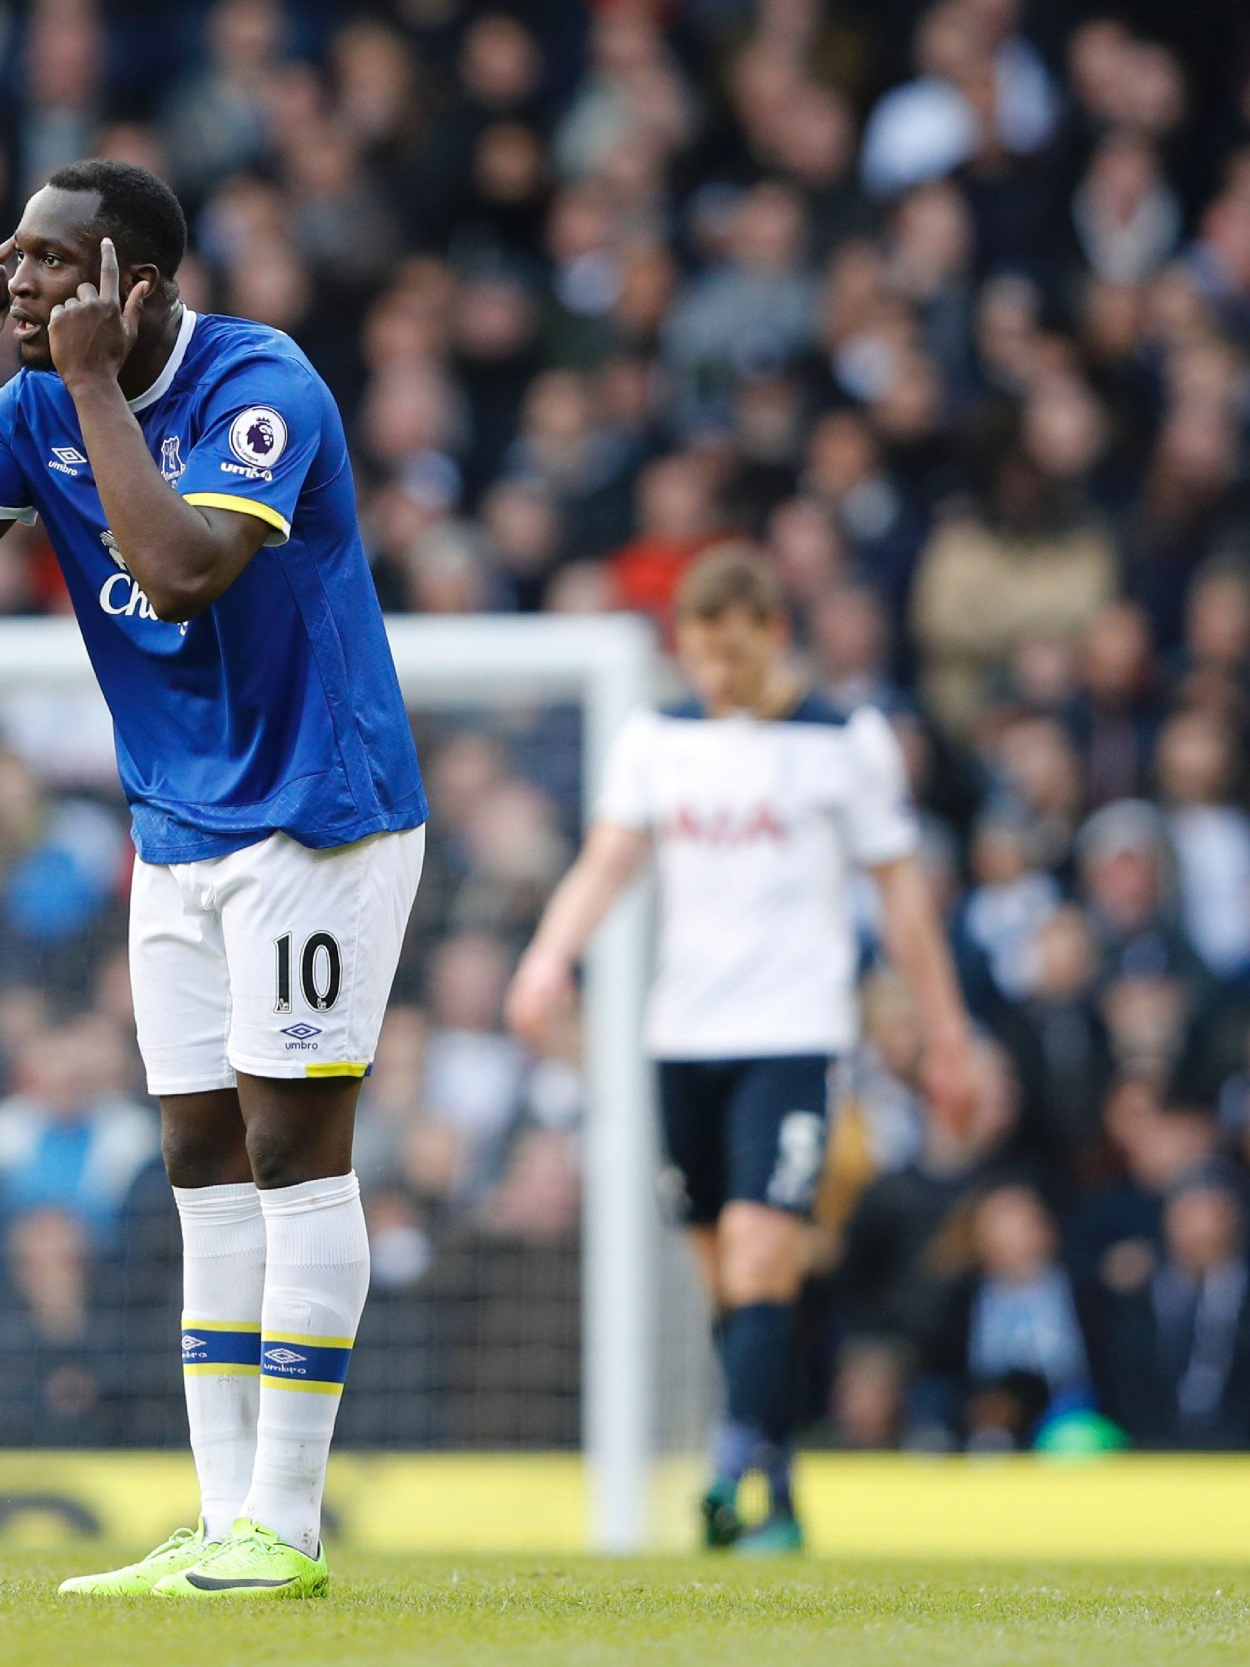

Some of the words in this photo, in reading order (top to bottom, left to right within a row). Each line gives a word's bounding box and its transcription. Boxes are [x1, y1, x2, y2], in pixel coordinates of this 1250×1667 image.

[48, 459, 78, 476] umbro
[273, 929, 343, 1014] 10
[285, 1041, 318, 1050] umbro
[264, 1363, 306, 1374] umbro
